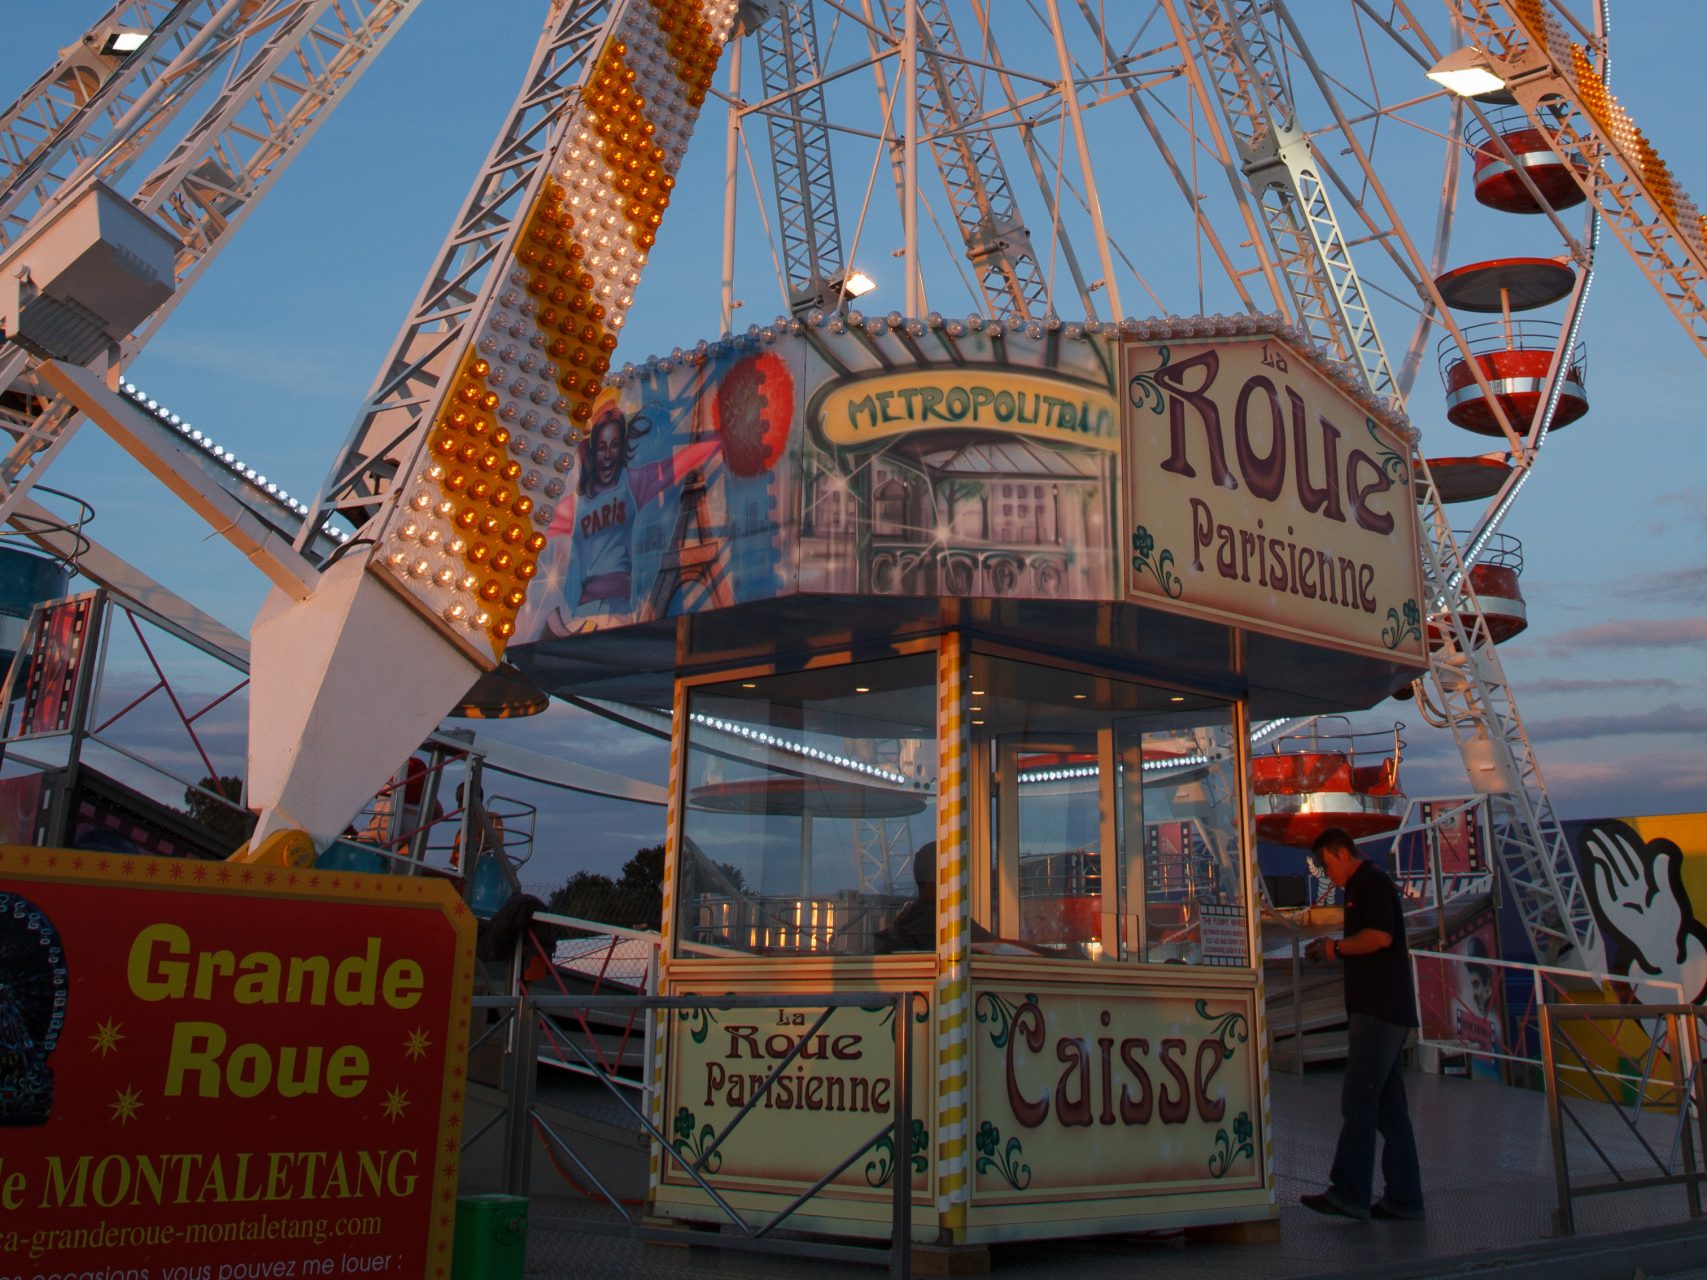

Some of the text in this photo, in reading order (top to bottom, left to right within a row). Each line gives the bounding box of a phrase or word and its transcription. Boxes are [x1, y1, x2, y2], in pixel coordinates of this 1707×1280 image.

[1261, 344, 1288, 374] La
[1154, 349, 1395, 535] Roue
[1189, 498, 1377, 614] Parisienne
[127, 923, 424, 1010] Grande
[724, 1025, 863, 1060] Roue
[776, 1009, 805, 1026] La
[164, 1021, 370, 1099] Roue
[705, 1061, 891, 1114] Parisienne
[1006, 1002, 1226, 1128] Caisse
[0, 1149, 419, 1210] e MONTALETANG
[162, 1264, 211, 1280] vous
[218, 1259, 296, 1280] pouvez
[302, 1259, 335, 1275] me
[341, 1253, 391, 1273] louer
